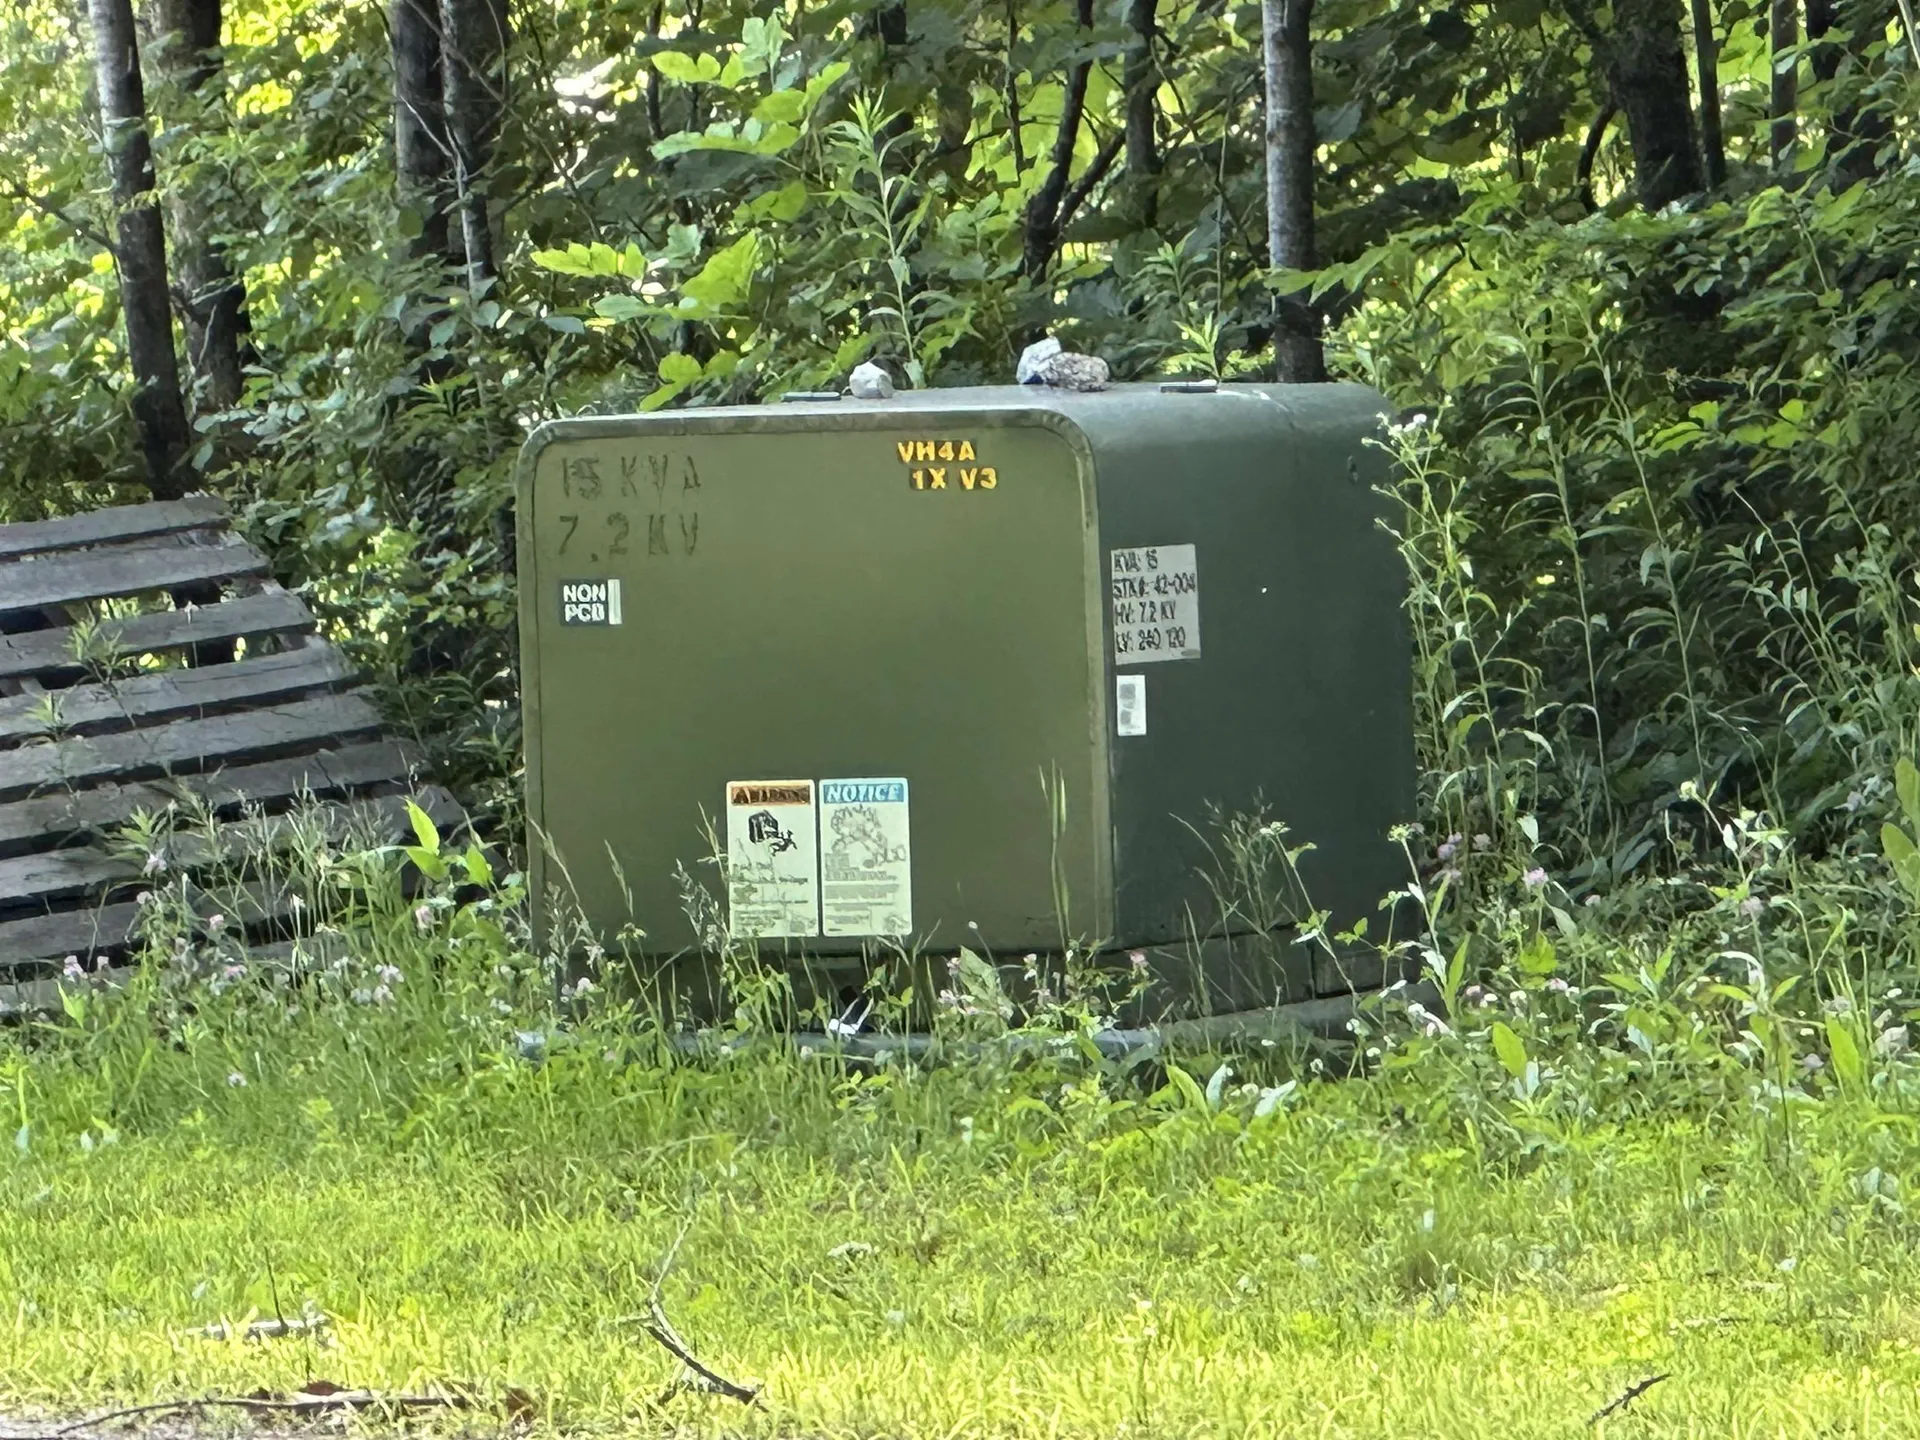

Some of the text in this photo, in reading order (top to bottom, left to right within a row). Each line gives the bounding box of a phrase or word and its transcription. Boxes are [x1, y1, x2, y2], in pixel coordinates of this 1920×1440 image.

[897, 440, 976, 464] VH4A
[561, 457, 601, 500] 15
[959, 467, 997, 490] V3
[562, 583, 607, 602] NON
[826, 783, 901, 802] NOTICE
